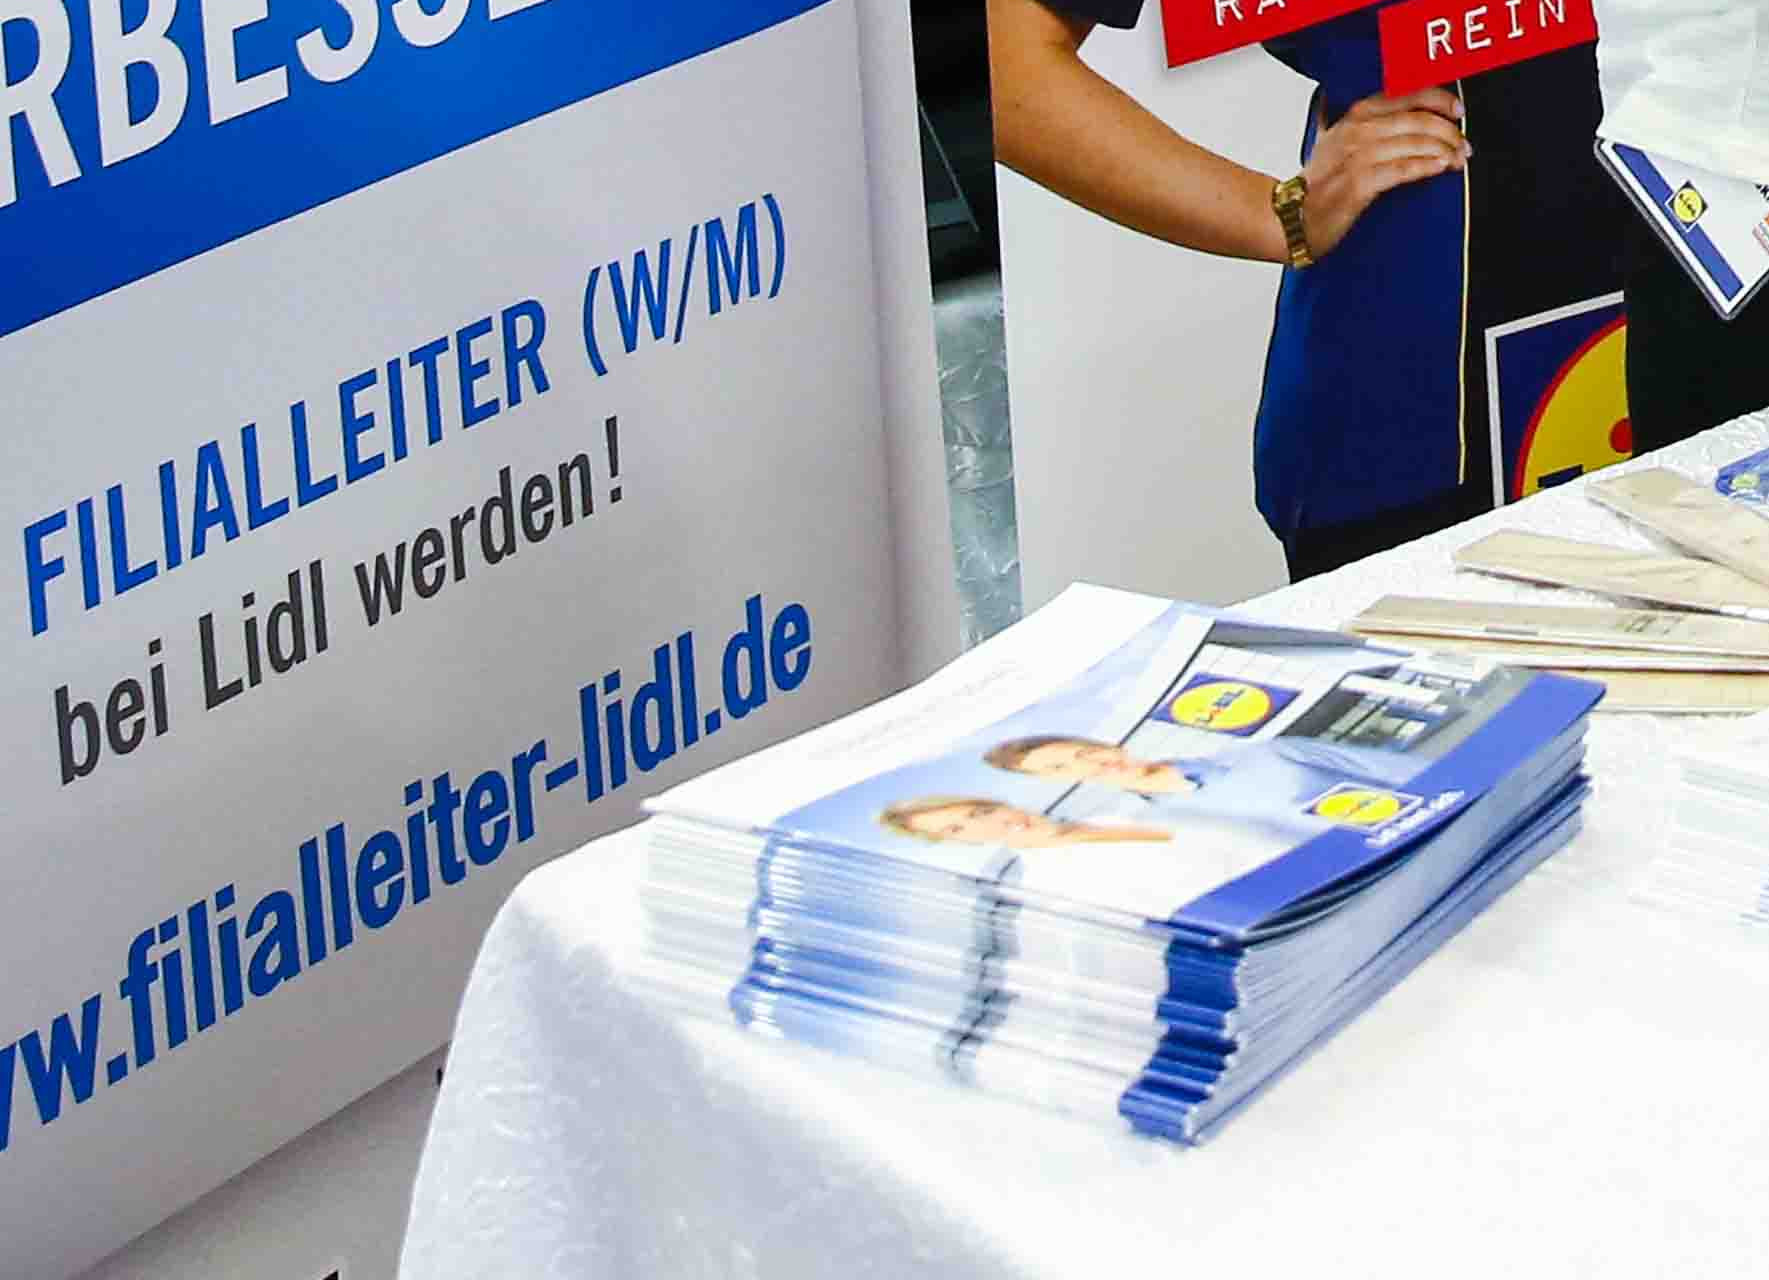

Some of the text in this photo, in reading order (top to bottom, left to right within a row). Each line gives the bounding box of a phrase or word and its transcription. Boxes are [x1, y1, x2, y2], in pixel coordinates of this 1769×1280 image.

[23, 192, 788, 638] FILIALLEITER (W/M)
[54, 416, 625, 785] bei Lidl werden!
[0, 594, 812, 1153] w.filialleiter-lidl.de
